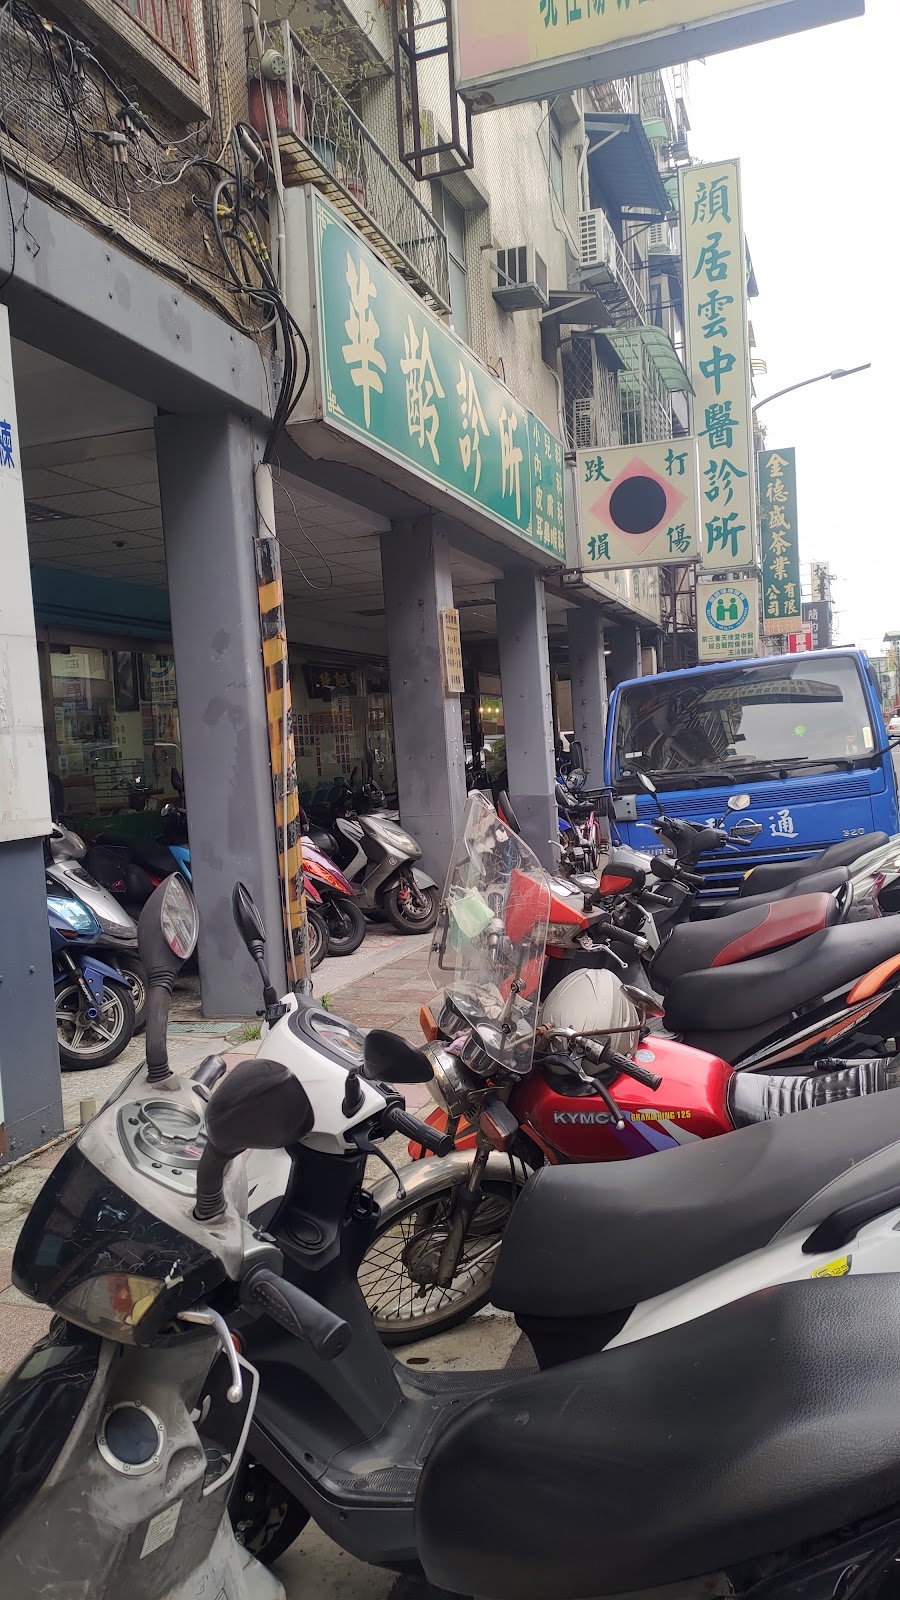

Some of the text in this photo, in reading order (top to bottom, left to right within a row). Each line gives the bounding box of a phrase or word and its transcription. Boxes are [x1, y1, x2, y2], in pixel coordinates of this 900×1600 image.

[690, 175, 748, 558] 顏居雲中醫診所
[341, 250, 524, 521] 華齡診所
[584, 448, 689, 483] 跌 打
[765, 453, 792, 581] 金德盛茶業
[587, 523, 692, 561] 損 傷
[769, 808, 800, 839] 通
[842, 827, 865, 837] 320
[630, 1112, 656, 1122] GRAND
[676, 1110, 691, 1119] 125
